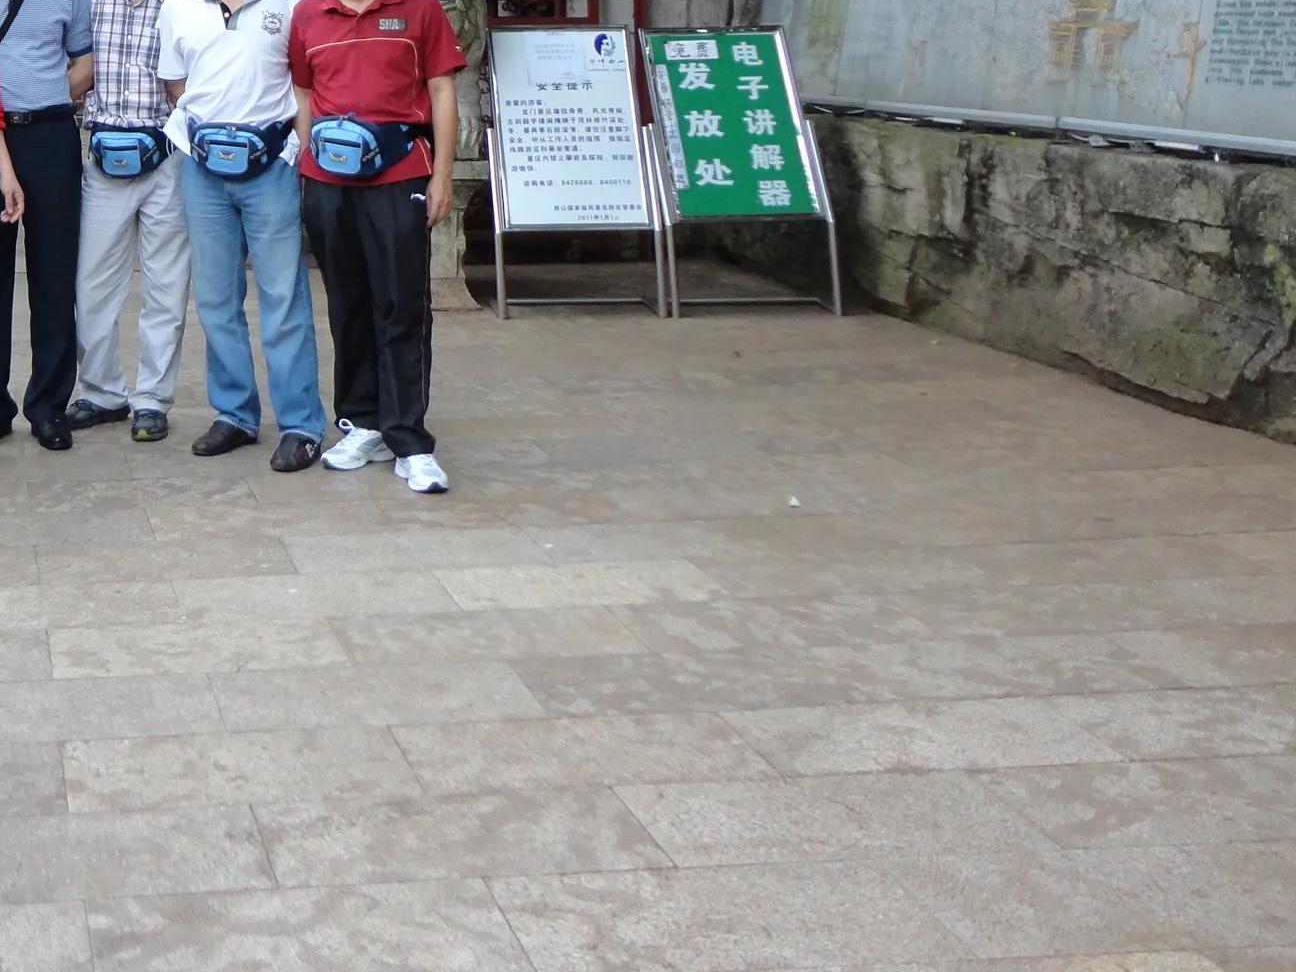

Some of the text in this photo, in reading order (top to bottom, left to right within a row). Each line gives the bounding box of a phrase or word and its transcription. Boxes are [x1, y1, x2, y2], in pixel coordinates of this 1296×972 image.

[670, 40, 709, 58] 免费
[536, 80, 594, 91] 安全提示
[678, 62, 735, 186] 发放处
[732, 41, 792, 207] 电子讲解器
